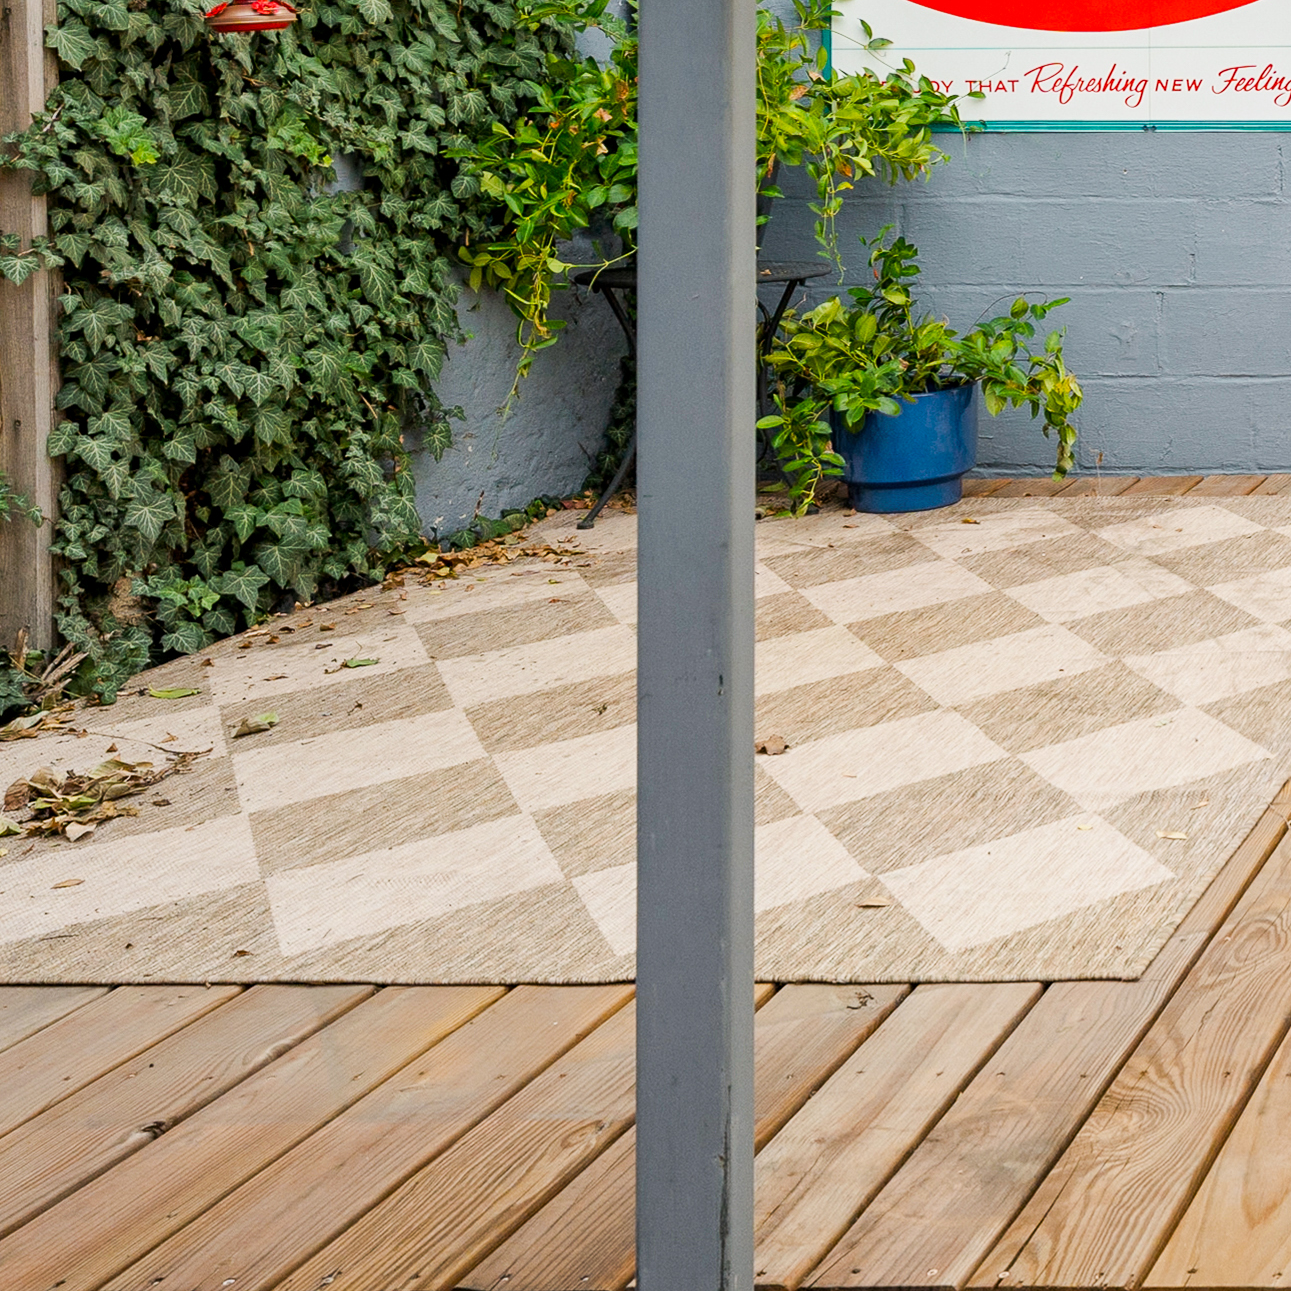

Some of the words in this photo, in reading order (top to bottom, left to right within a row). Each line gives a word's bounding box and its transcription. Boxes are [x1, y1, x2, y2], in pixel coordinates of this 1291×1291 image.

[965, 79, 1019, 93] THAT
[1023, 62, 1149, 108] Refreshing
[1154, 78, 1203, 92] NEW
